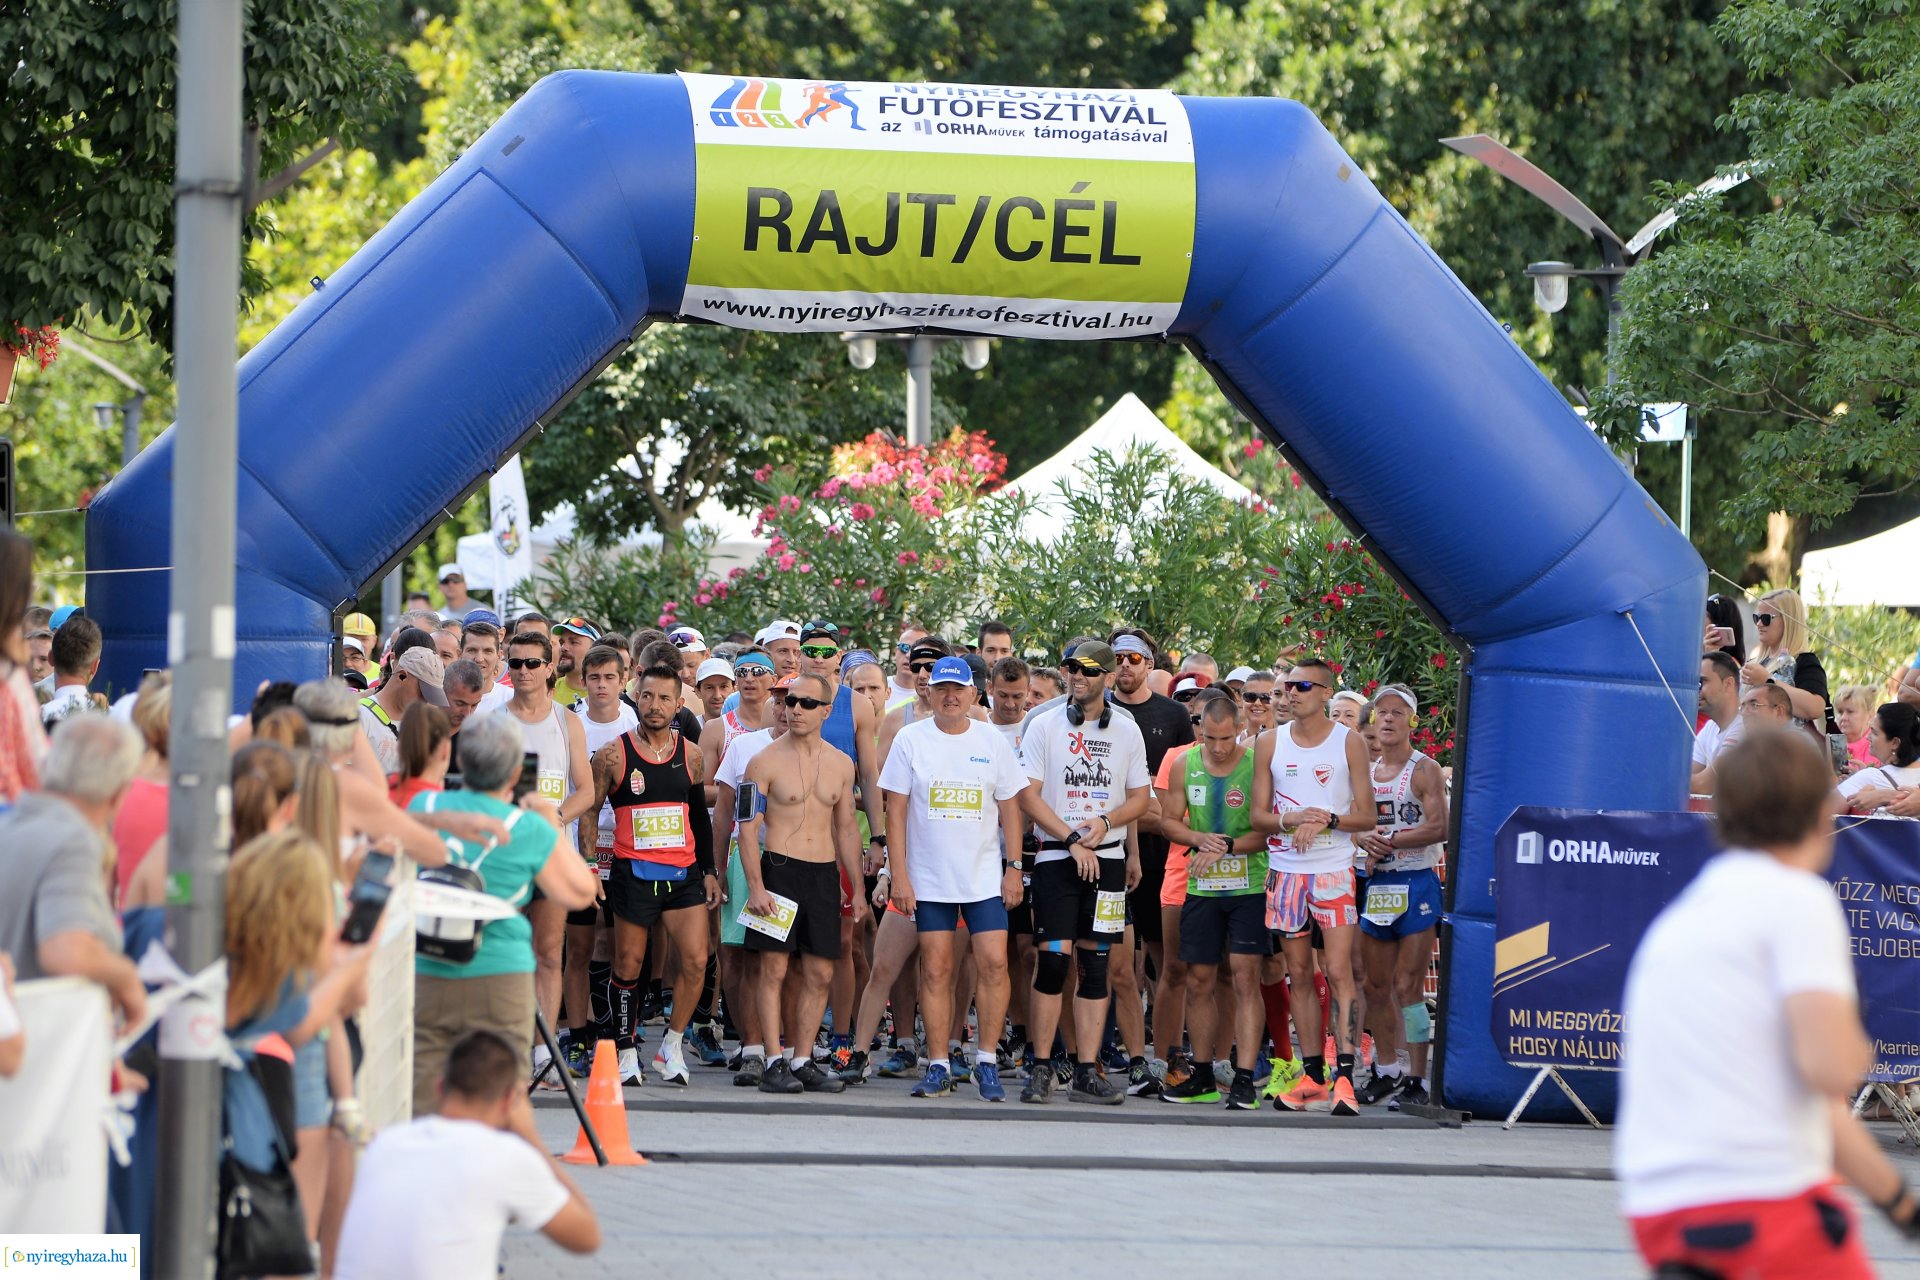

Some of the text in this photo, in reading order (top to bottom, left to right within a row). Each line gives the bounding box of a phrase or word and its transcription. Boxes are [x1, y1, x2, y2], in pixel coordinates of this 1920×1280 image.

[878, 95, 1168, 126] FUTÓFESZTIVÁL
[880, 121, 902, 133] az
[1033, 125, 1168, 144] támogatásával
[742, 181, 1142, 266] RAJT/CÉL
[703, 299, 1153, 329] www.nyiregyhazifutofesztival.hu
[1088, 746, 1112, 754] TRAIL
[933, 788, 978, 804] 2286
[1067, 790, 1082, 798] HELL
[638, 816, 680, 832] 2135
[1548, 838, 1661, 867] ORHAMŰVEK
[1204, 859, 1242, 874] 169
[1369, 894, 1403, 909] 2320
[1847, 908, 1872, 929] TE
[1509, 1008, 1531, 1029] MI
[1509, 1035, 1558, 1057] HOGY
